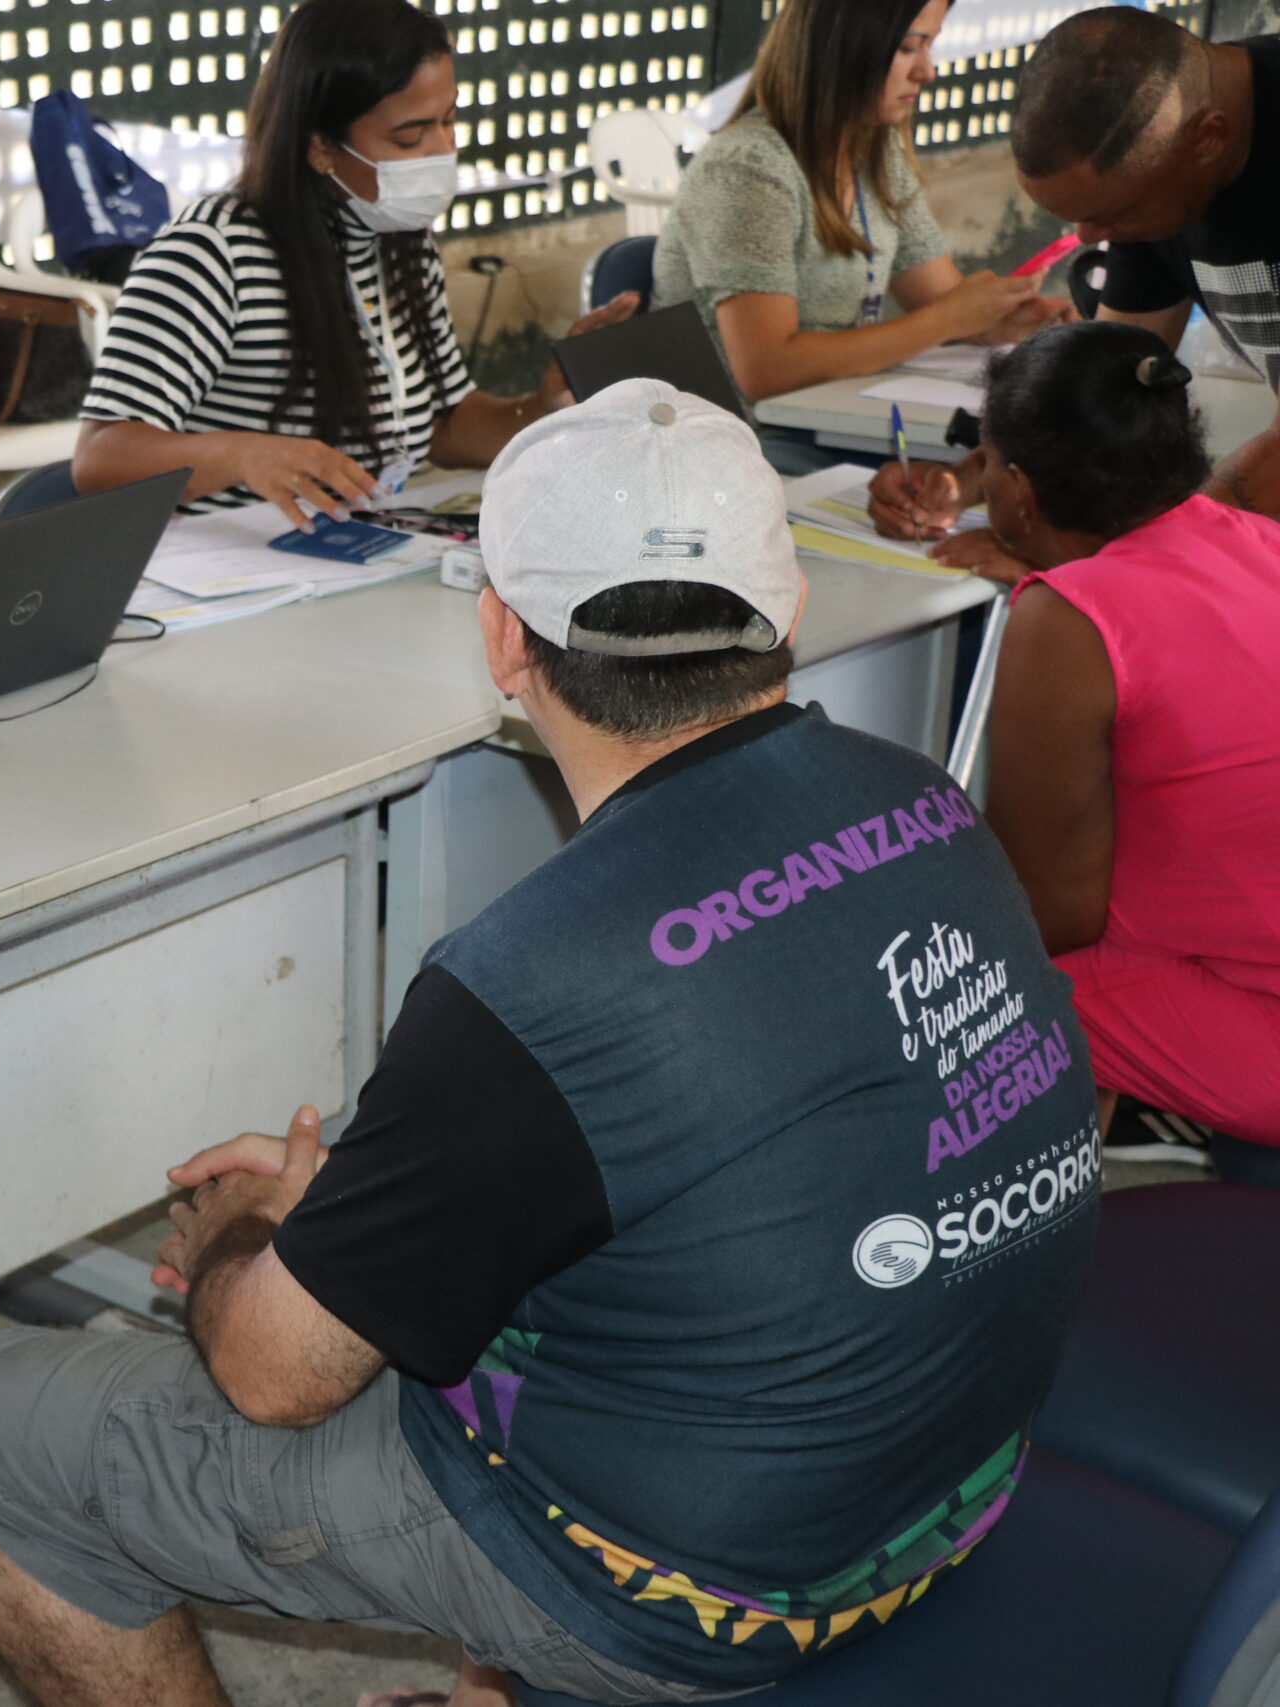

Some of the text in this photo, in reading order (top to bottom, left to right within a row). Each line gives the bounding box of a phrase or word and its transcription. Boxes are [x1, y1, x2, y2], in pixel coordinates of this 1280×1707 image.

[649, 784, 978, 966] ORGANIZAÇÃO
[876, 921, 974, 1028] Festa
[902, 958, 1008, 1062] e tradição
[937, 991, 1024, 1080] do tamanho
[943, 1019, 1041, 1110] DA NOSSA
[926, 1018, 1073, 1175] ALEGRIA!
[935, 1127, 1102, 1260] SOCORRO
